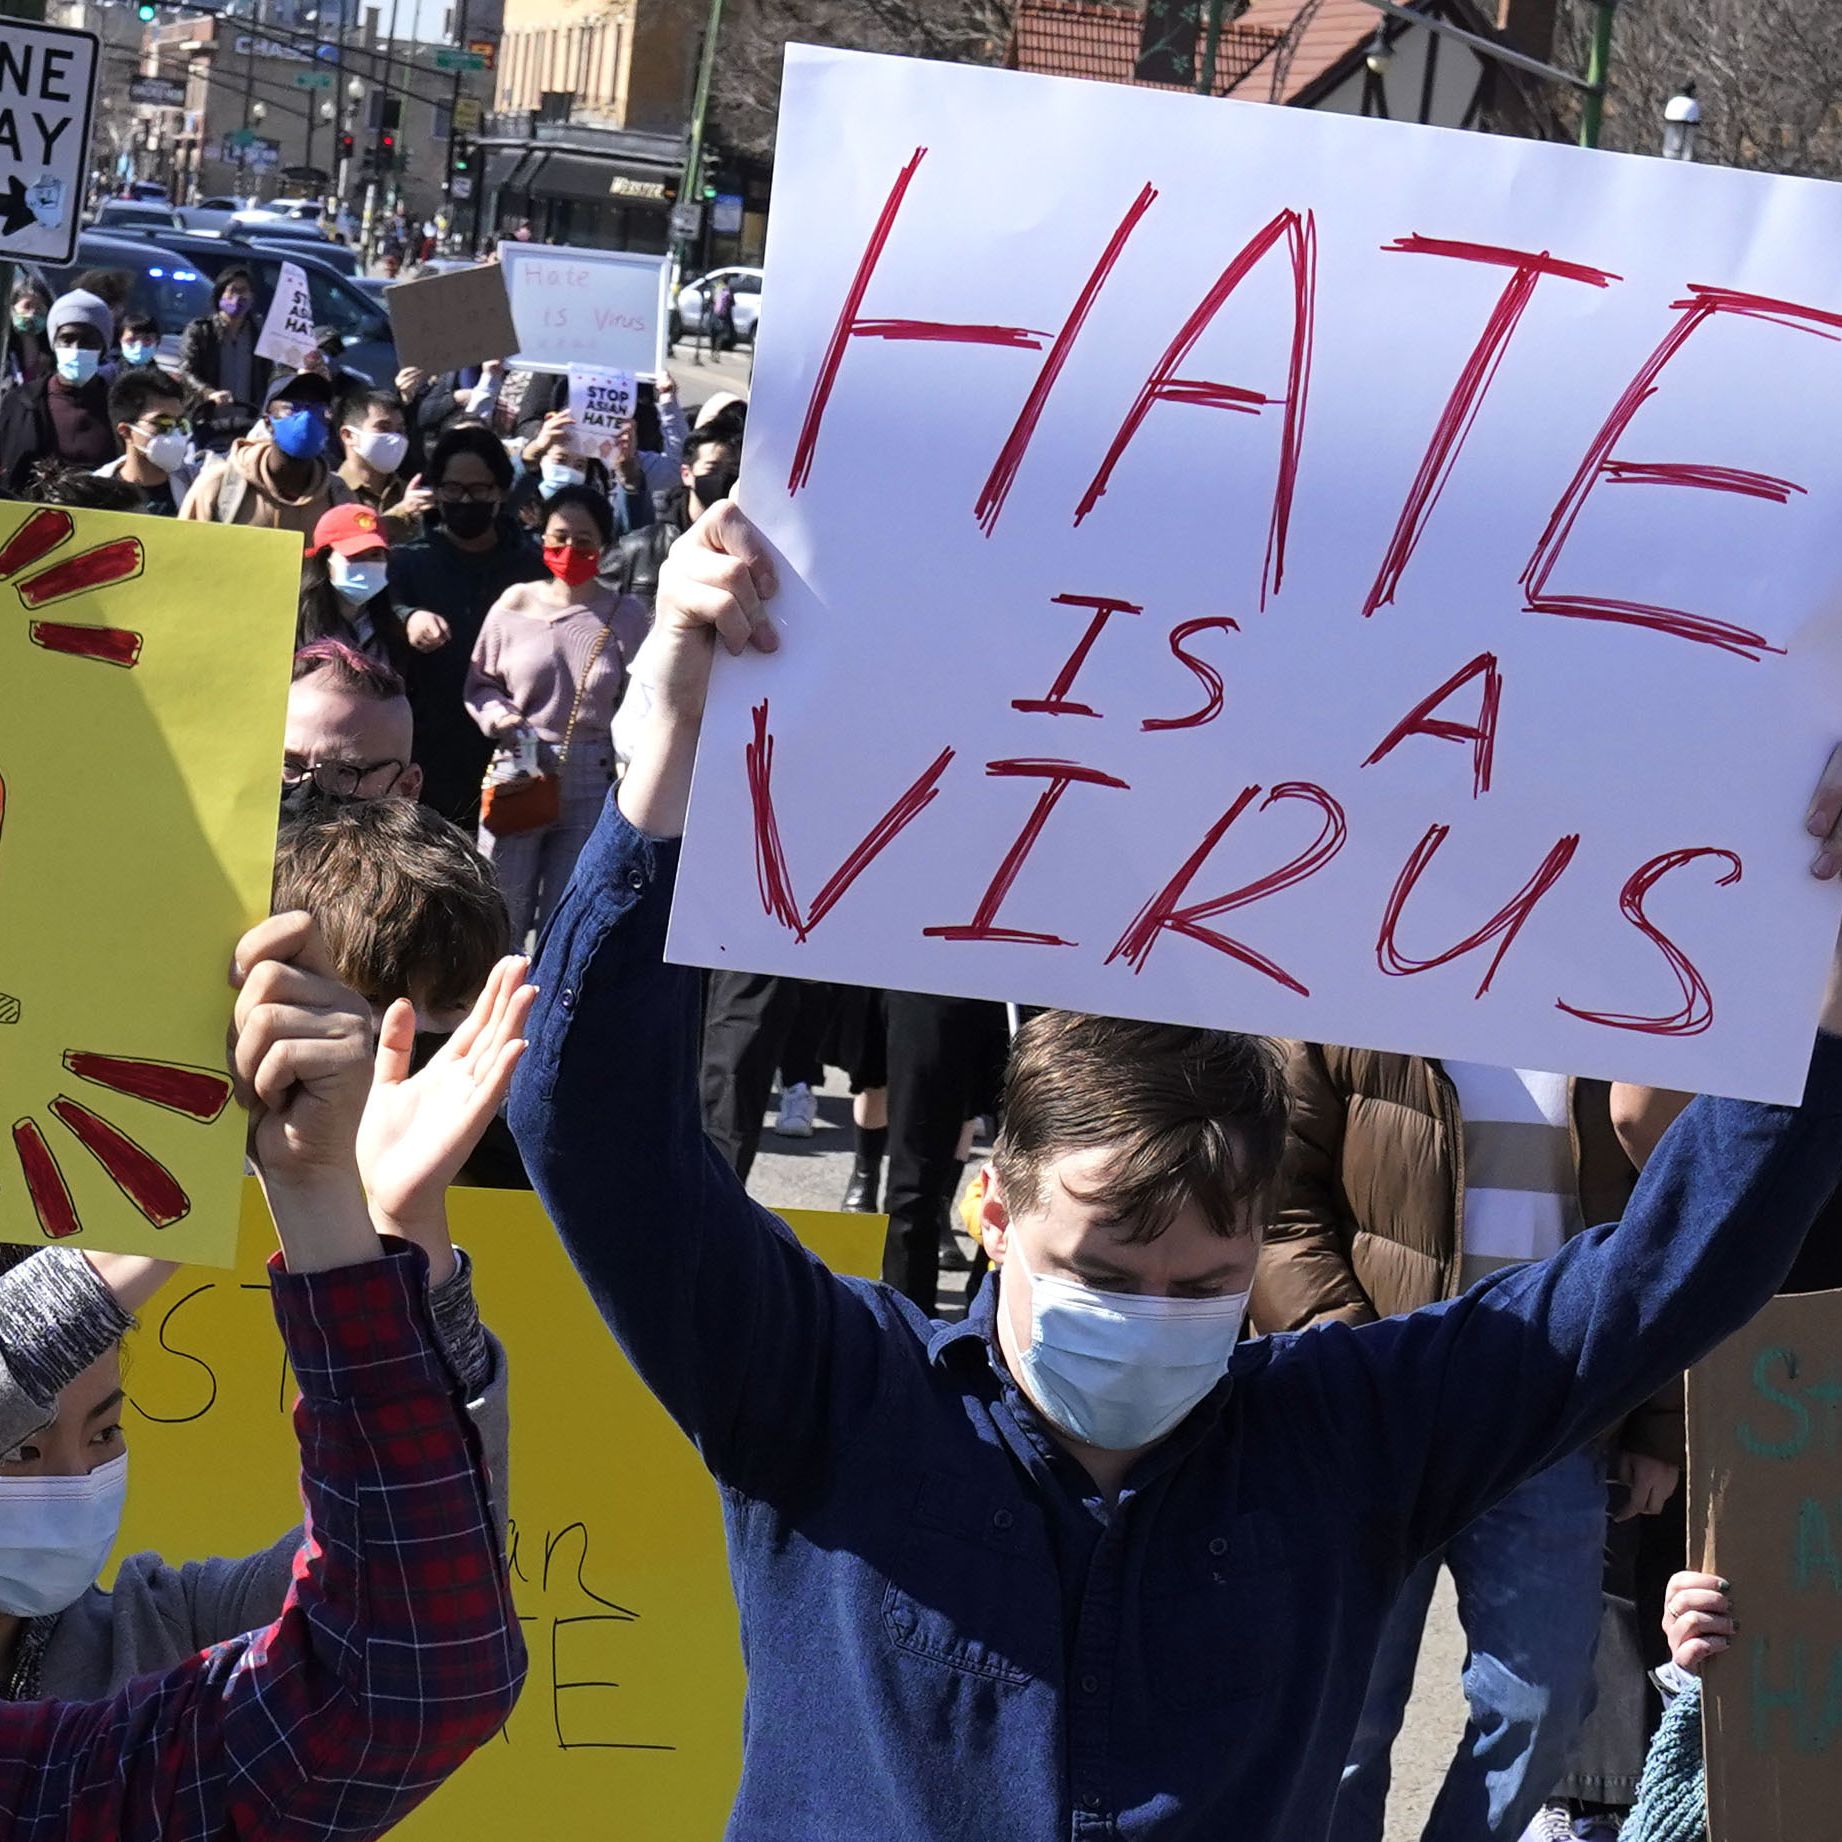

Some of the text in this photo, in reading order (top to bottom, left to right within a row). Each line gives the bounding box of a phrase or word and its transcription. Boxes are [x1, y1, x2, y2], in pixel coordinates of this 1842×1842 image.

[583, 412, 623, 429] HATE
[586, 401, 628, 415] ASIAN
[587, 386, 629, 402] STOP
[1009, 591, 1504, 798] IS A
[744, 697, 1744, 1037] VIRUS
[128, 1283, 288, 1424] ST
